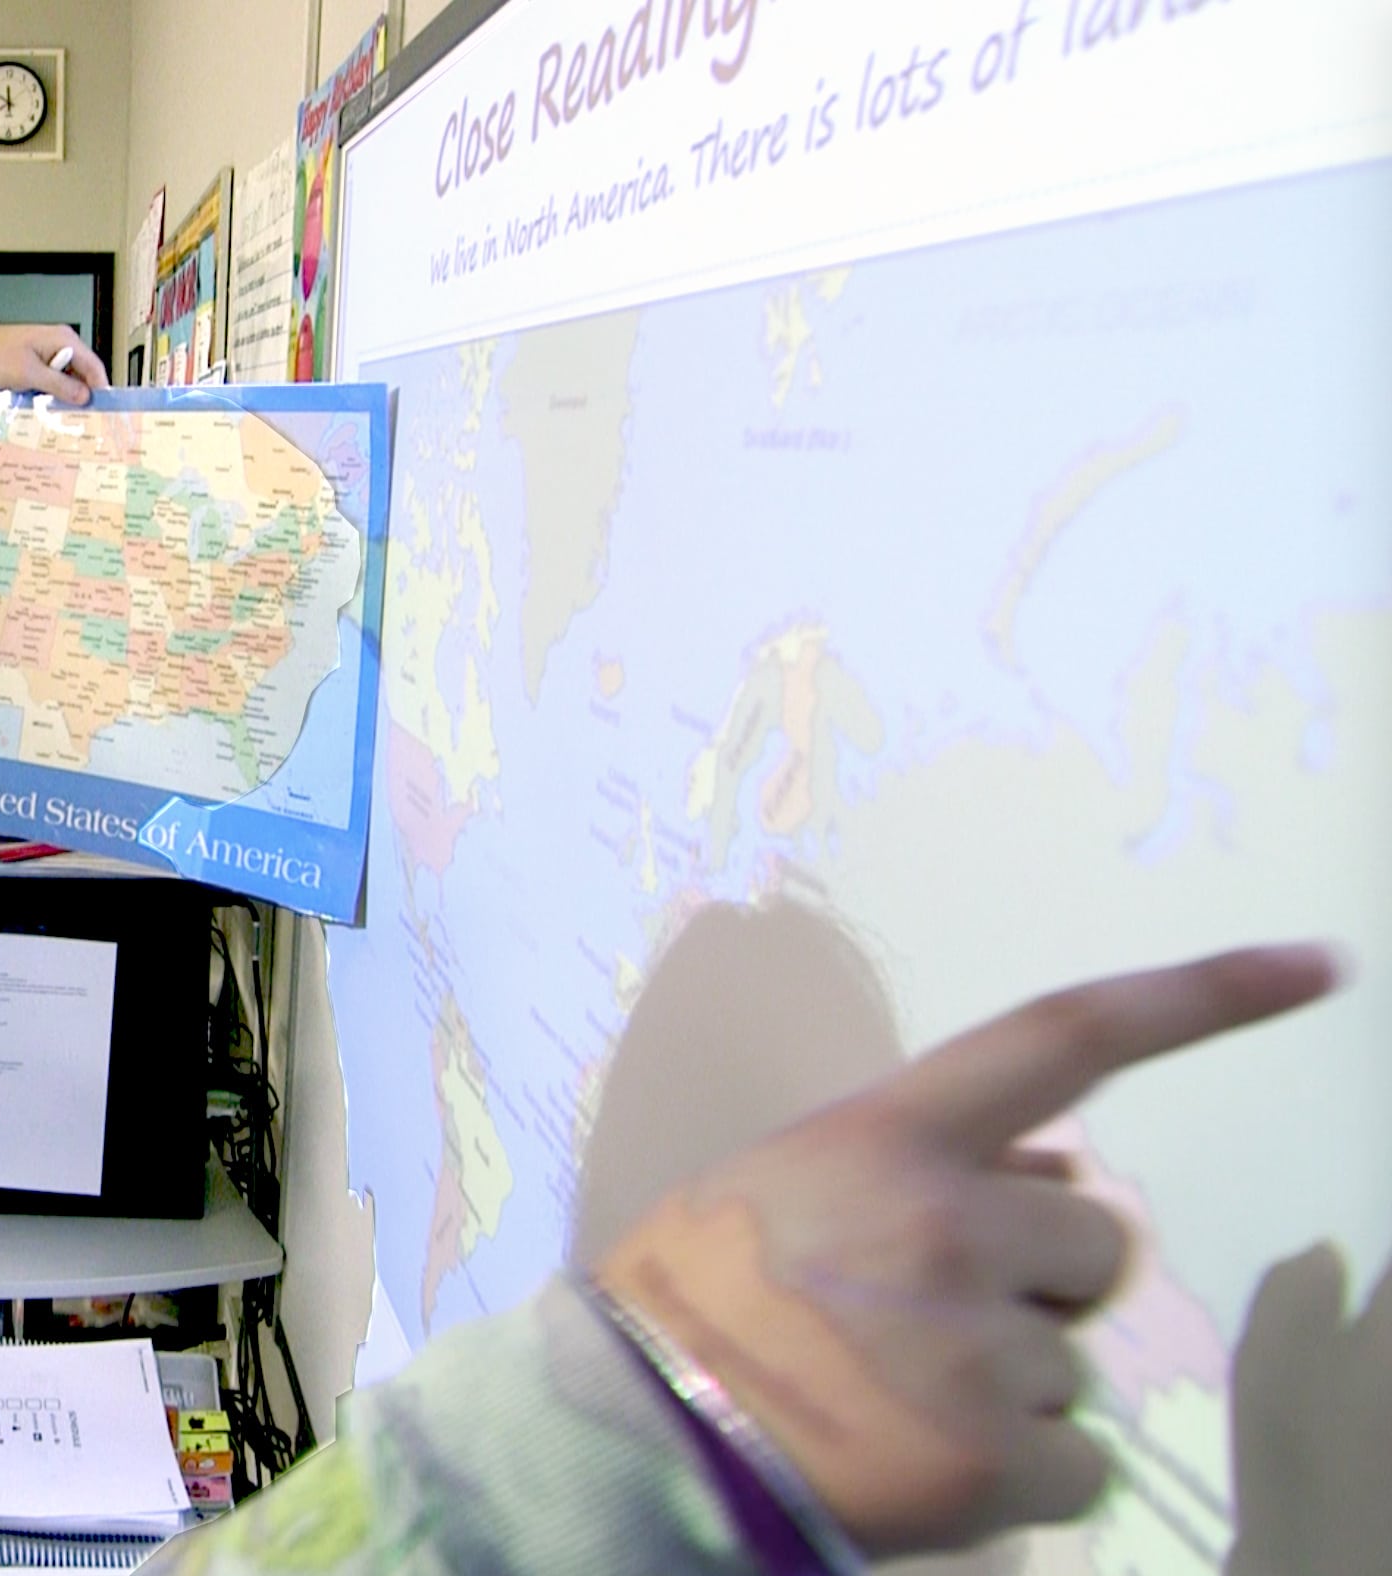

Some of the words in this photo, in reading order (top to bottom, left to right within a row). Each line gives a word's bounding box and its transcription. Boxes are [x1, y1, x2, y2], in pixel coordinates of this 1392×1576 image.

[430, 250, 450, 286] We
[453, 236, 477, 277] live
[482, 223, 498, 269] in
[504, 195, 558, 259] North
[564, 156, 675, 235] America.
[691, 113, 789, 189] There
[804, 78, 840, 153] is
[855, 47, 951, 132] lots
[970, 0, 1039, 94] of
[435, 90, 515, 198] Close
[43, 797, 138, 841] States
[147, 820, 181, 850] of
[185, 829, 322, 890] America
